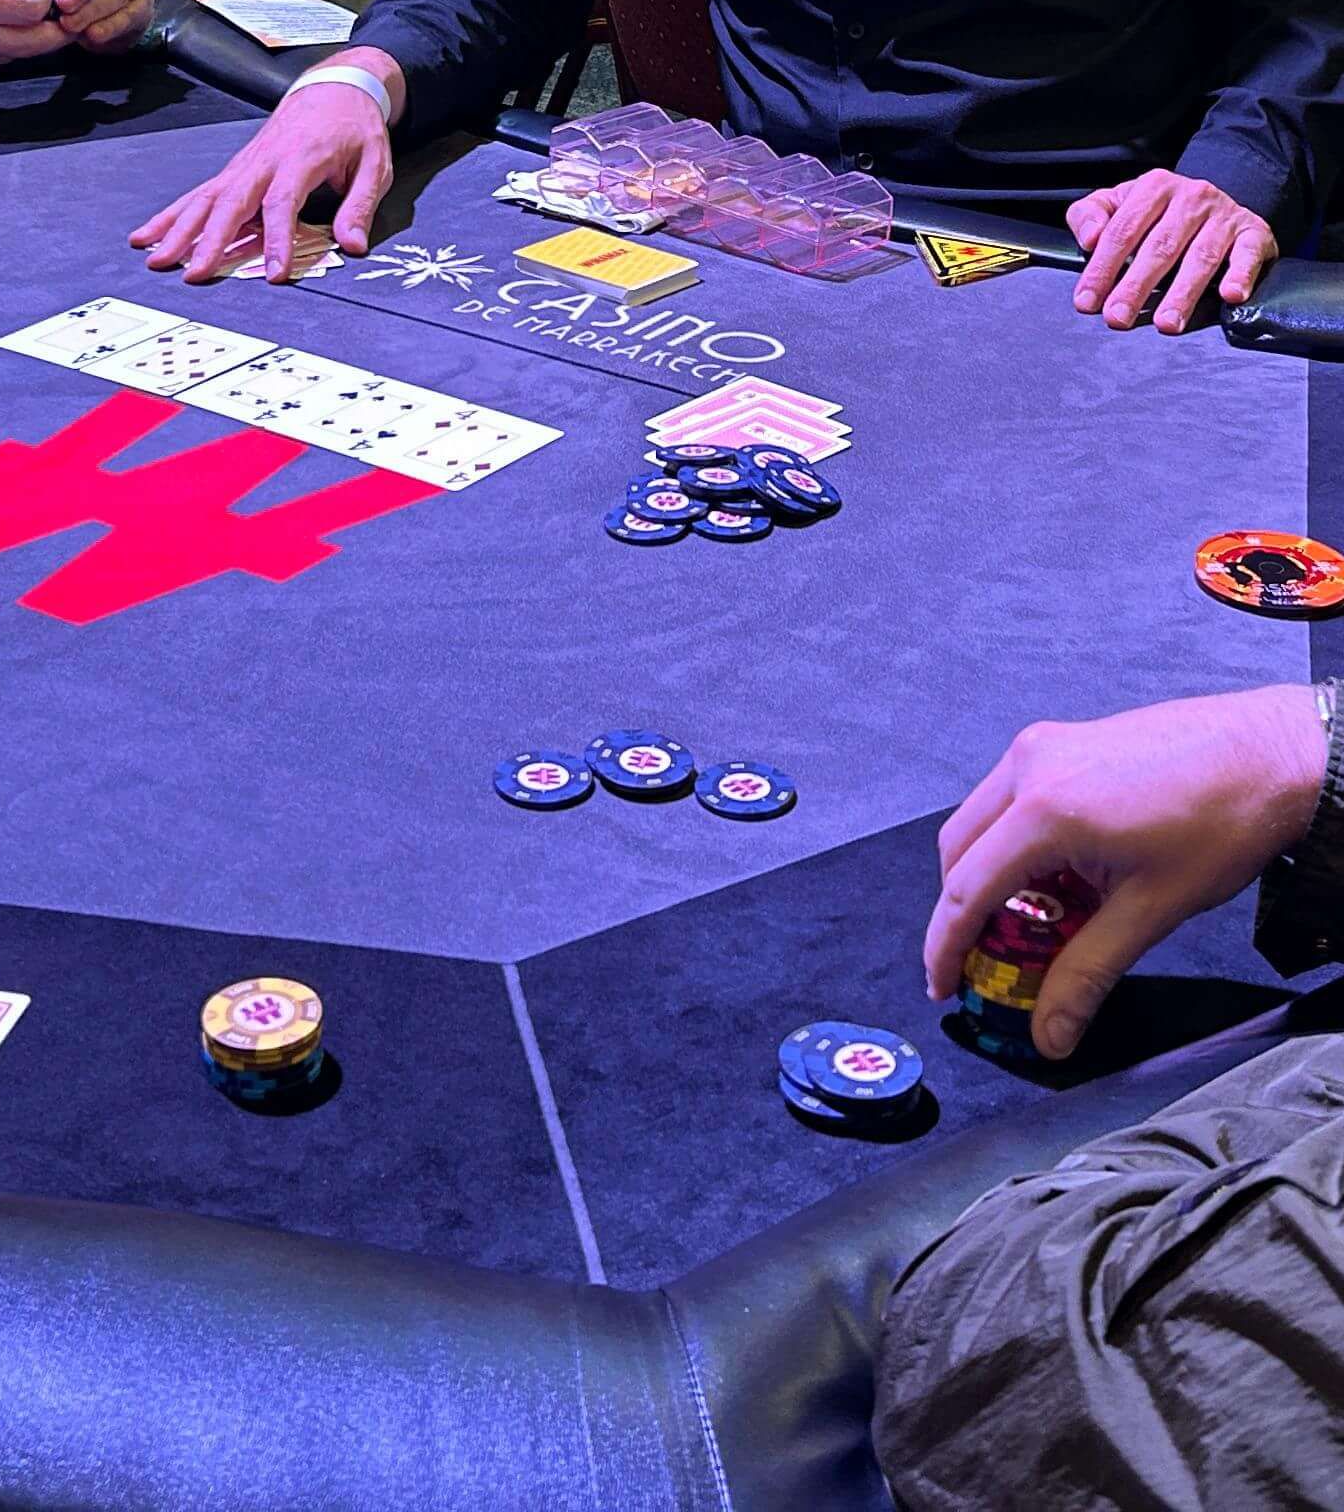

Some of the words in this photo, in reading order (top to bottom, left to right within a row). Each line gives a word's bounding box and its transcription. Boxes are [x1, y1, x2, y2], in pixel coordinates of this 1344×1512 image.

[452, 299, 512, 322] DE
[511, 315, 748, 385] MARRAKECH
[496, 279, 786, 363] CASINO
